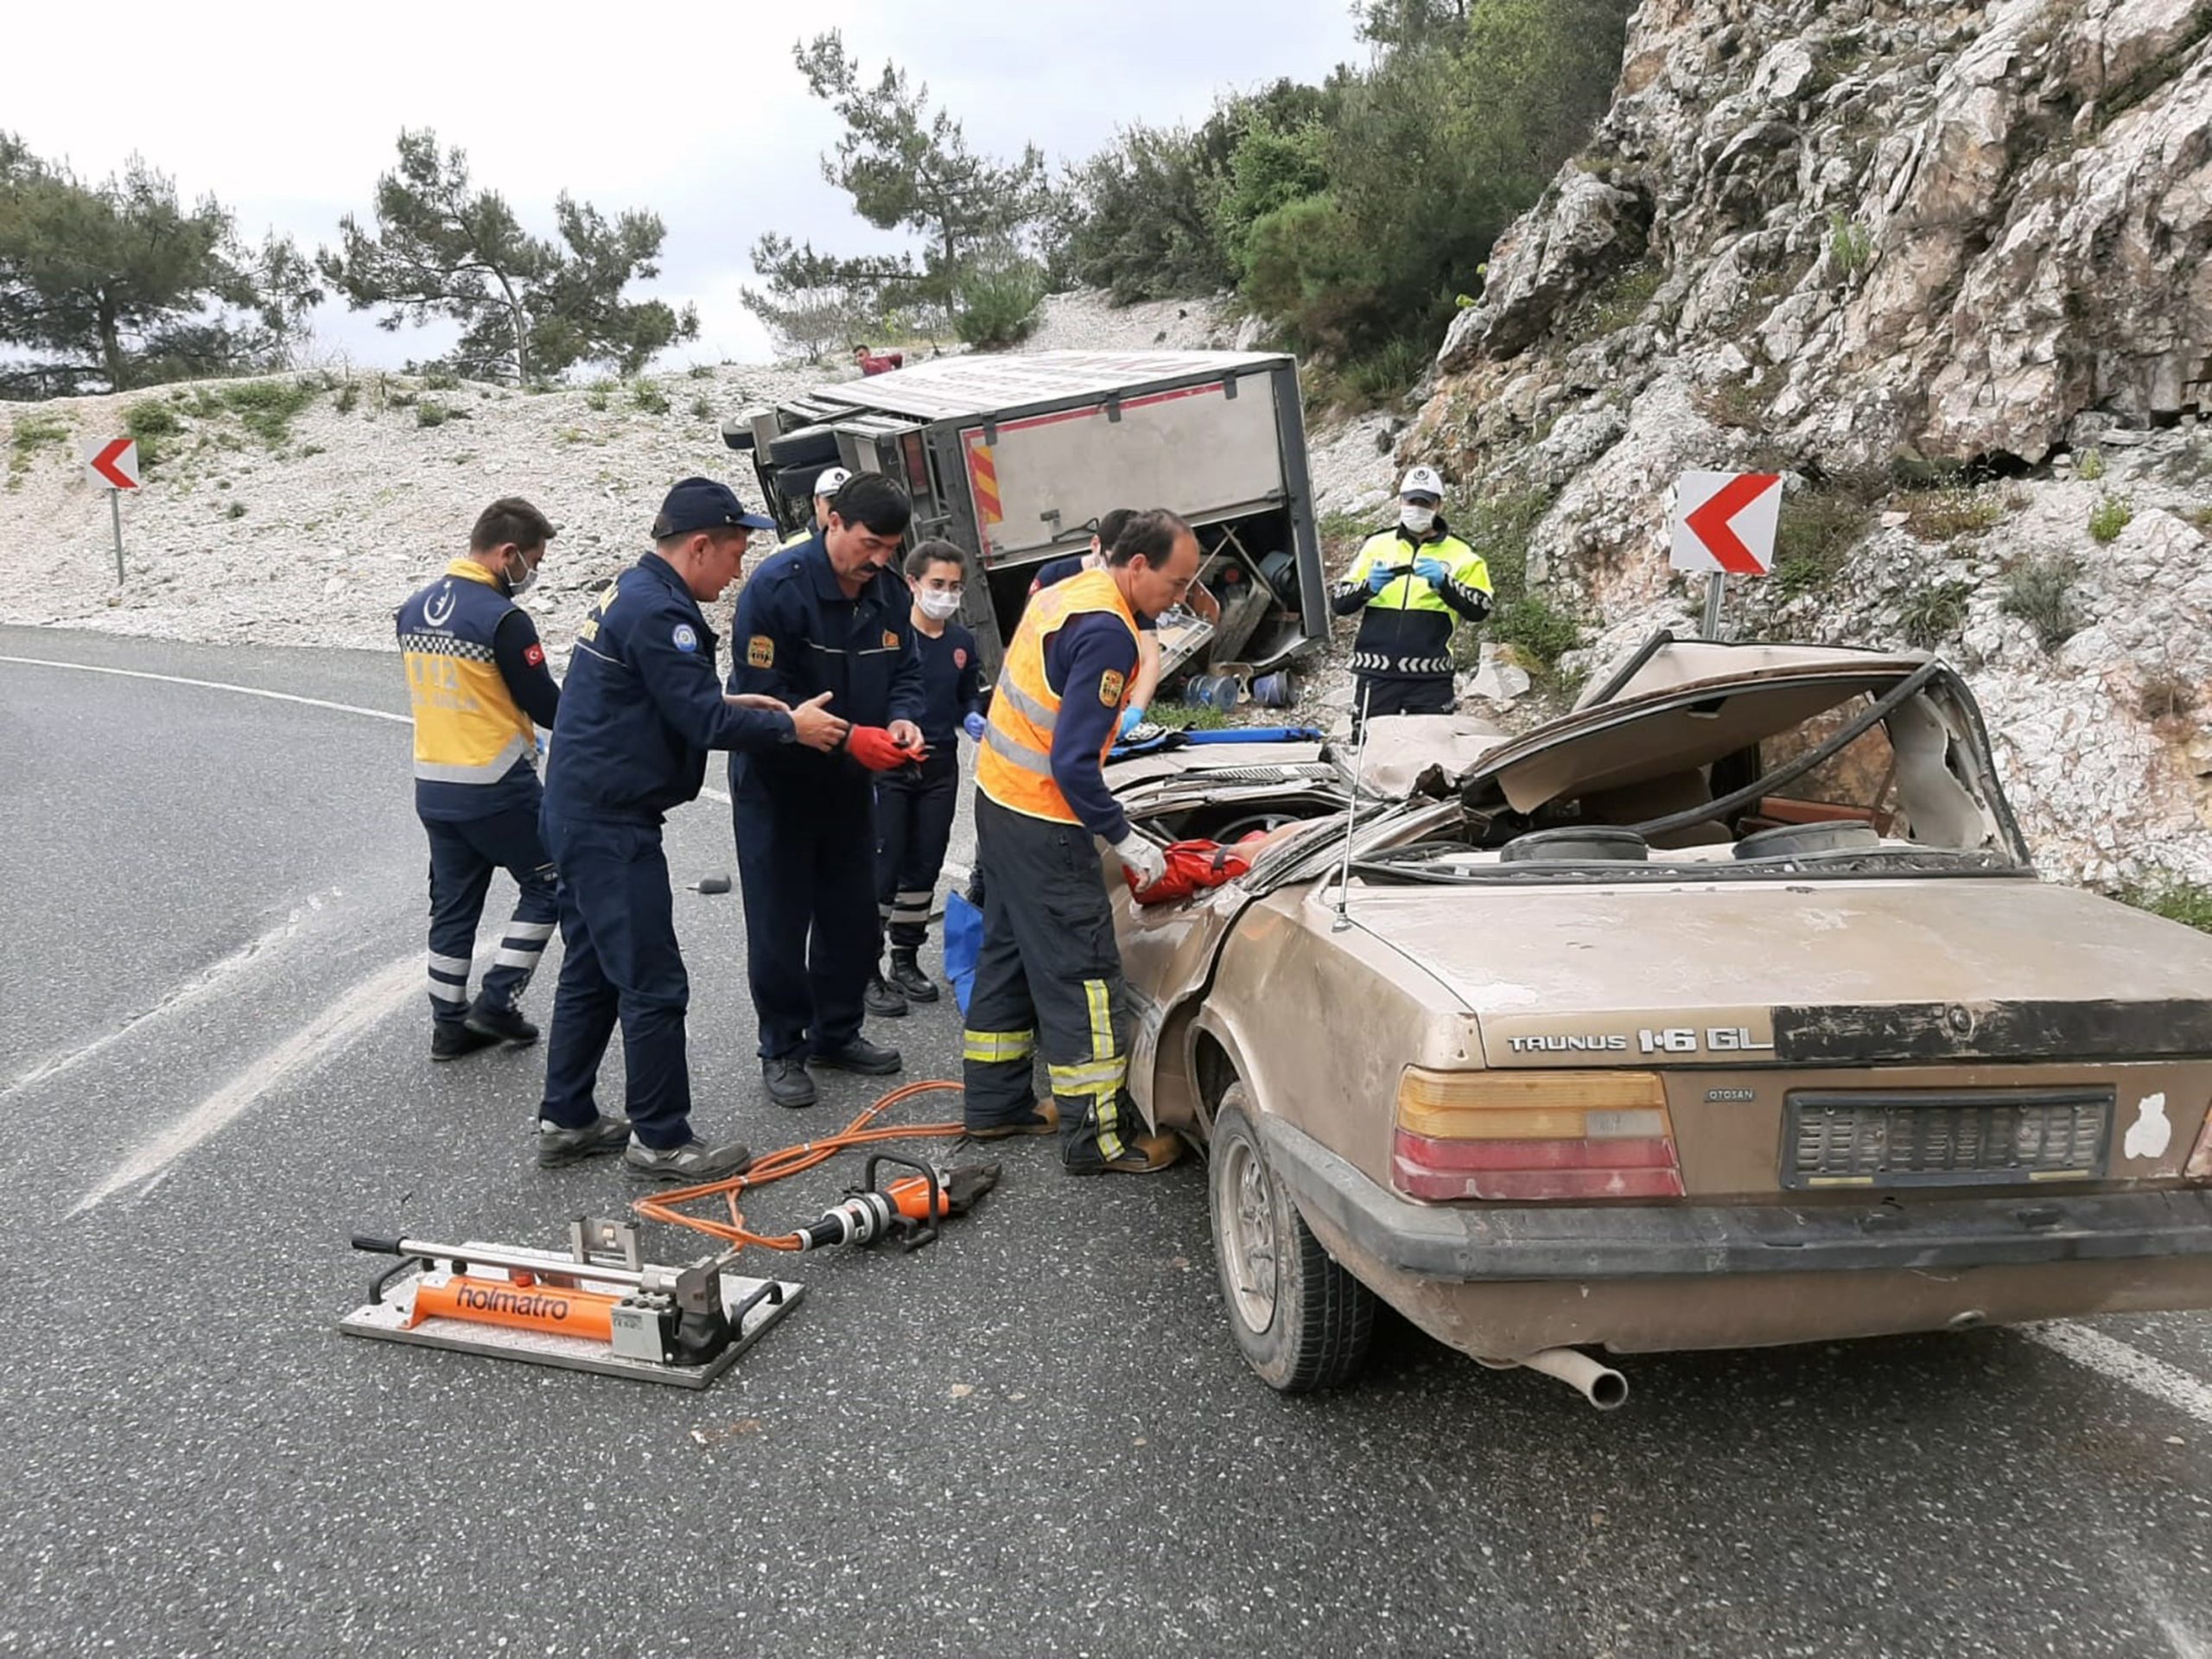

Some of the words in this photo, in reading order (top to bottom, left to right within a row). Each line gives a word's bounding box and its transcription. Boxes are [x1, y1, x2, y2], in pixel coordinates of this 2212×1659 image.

[1508, 1035, 1627, 1052] TAUNUS
[1706, 1027, 1775, 1051] GL
[1707, 1089, 1753, 1101] OTOSAN
[456, 1282, 568, 1321] holmatro
